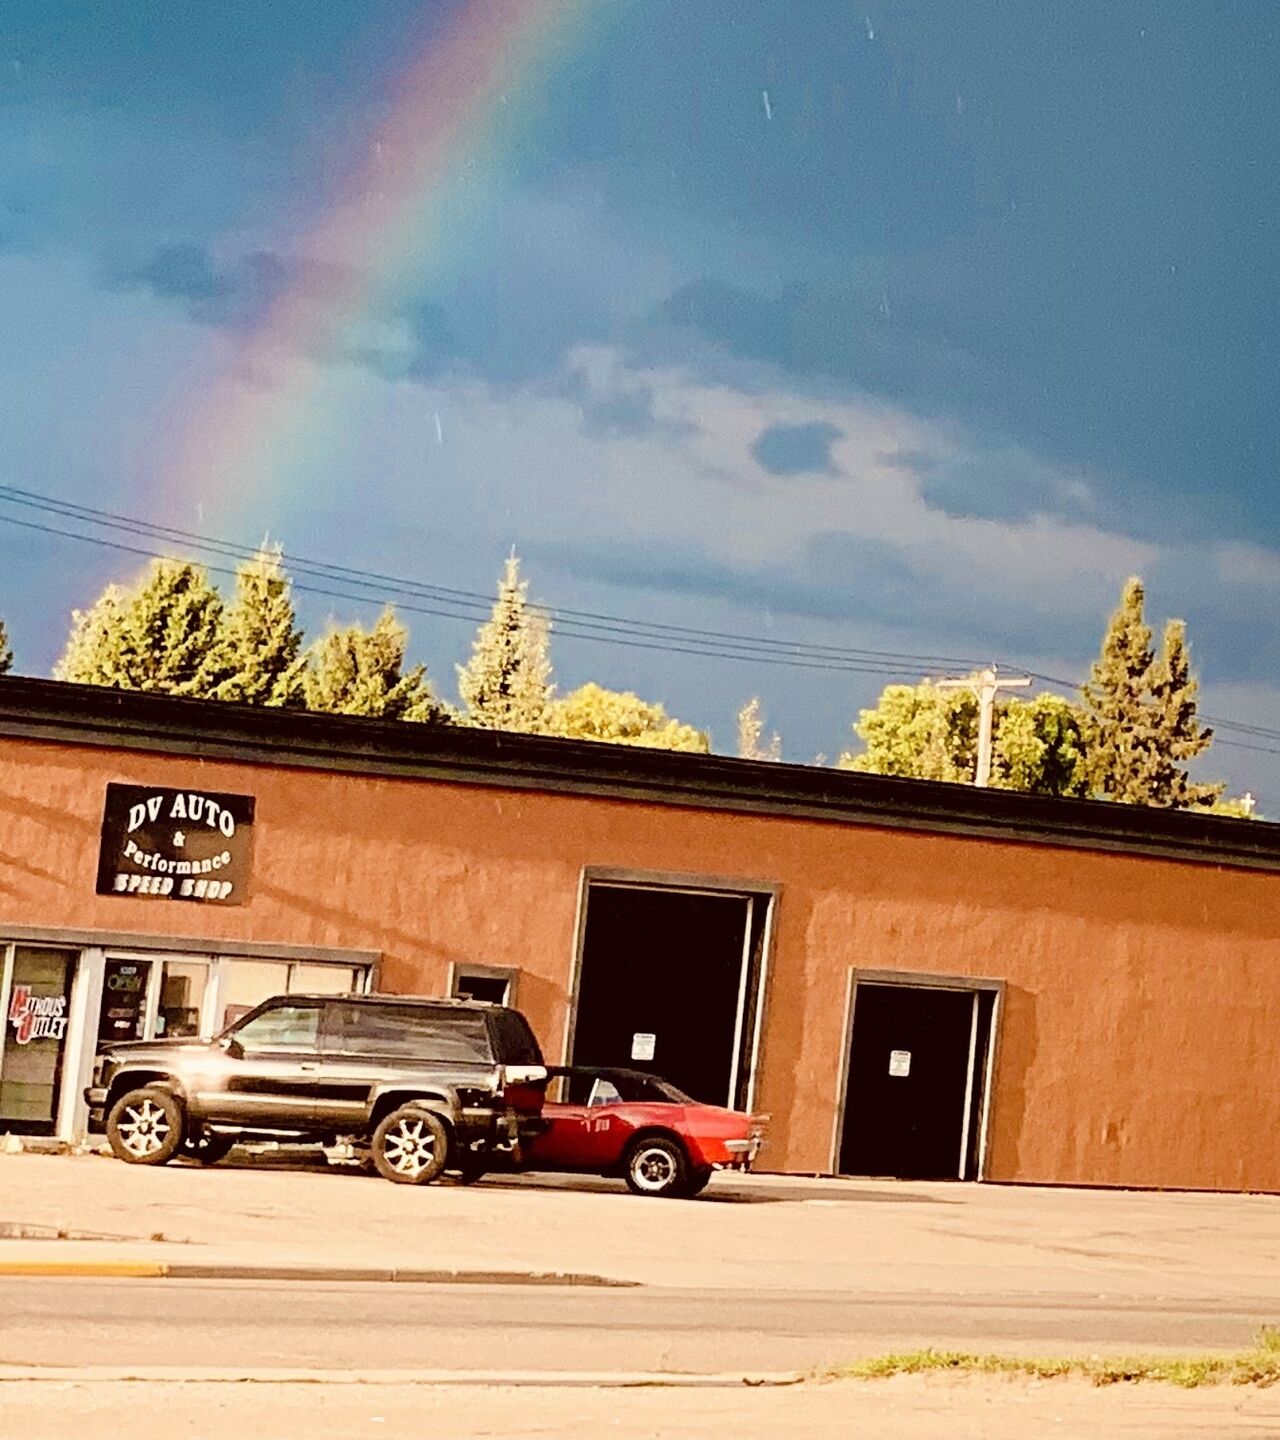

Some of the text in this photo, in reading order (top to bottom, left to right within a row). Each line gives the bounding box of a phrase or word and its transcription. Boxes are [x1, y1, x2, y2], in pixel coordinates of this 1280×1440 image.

[127, 793, 235, 838] DV AUTO
[172, 831, 186, 847] &
[123, 840, 231, 874] Performance
[113, 873, 233, 900] SPEED SHOP
[16, 1013, 68, 1044] OUTLET
